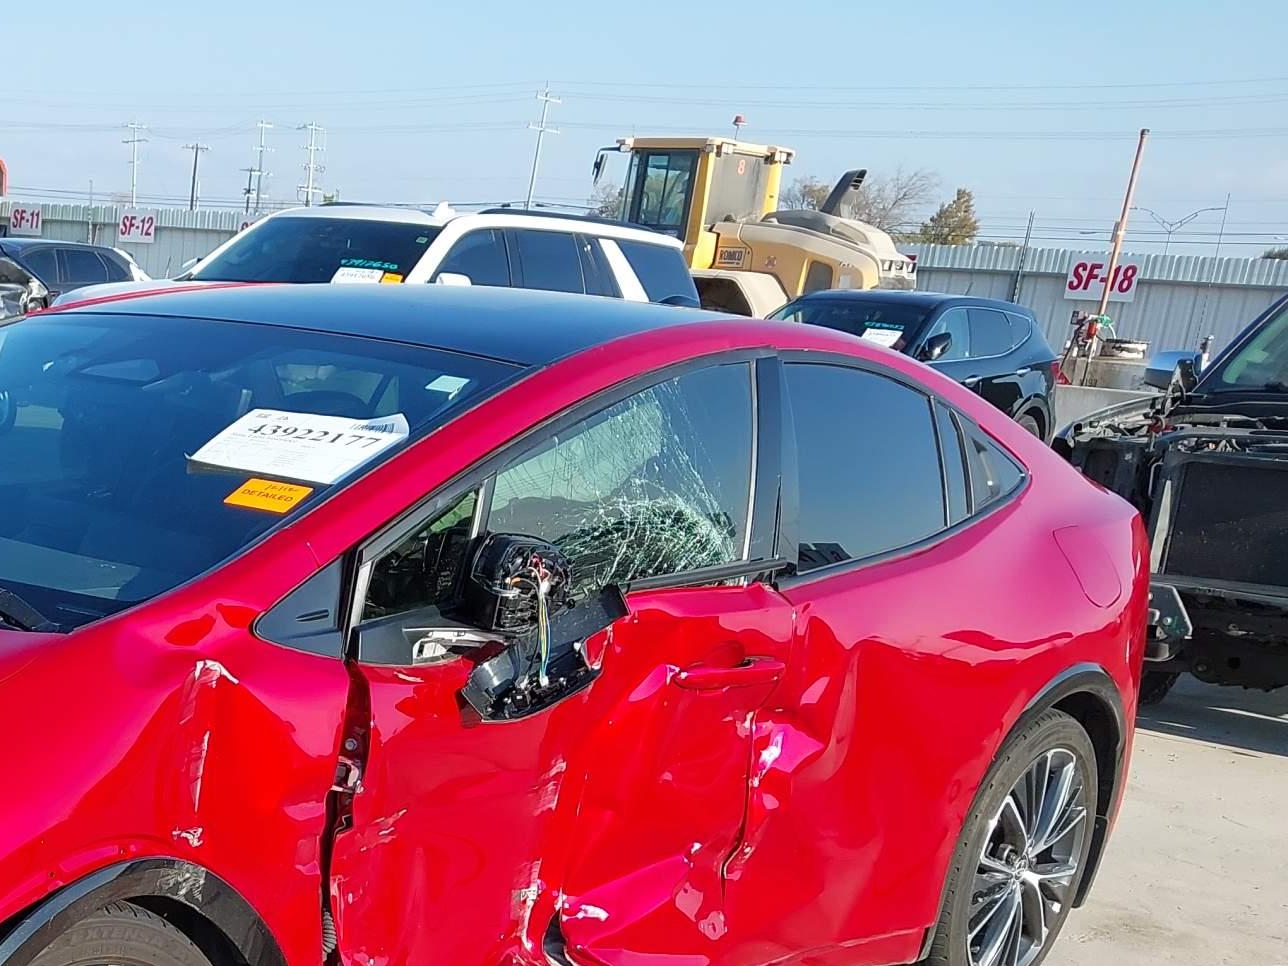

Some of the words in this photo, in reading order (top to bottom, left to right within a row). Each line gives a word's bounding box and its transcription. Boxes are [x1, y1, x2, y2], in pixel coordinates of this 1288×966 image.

[737, 159, 746, 175] 8
[12, 208, 40, 229] SF-11
[120, 215, 154, 237] SF-12
[1068, 262, 1138, 293] SF-18
[248, 423, 381, 448] 43922177
[241, 488, 294, 502] DETAILED
